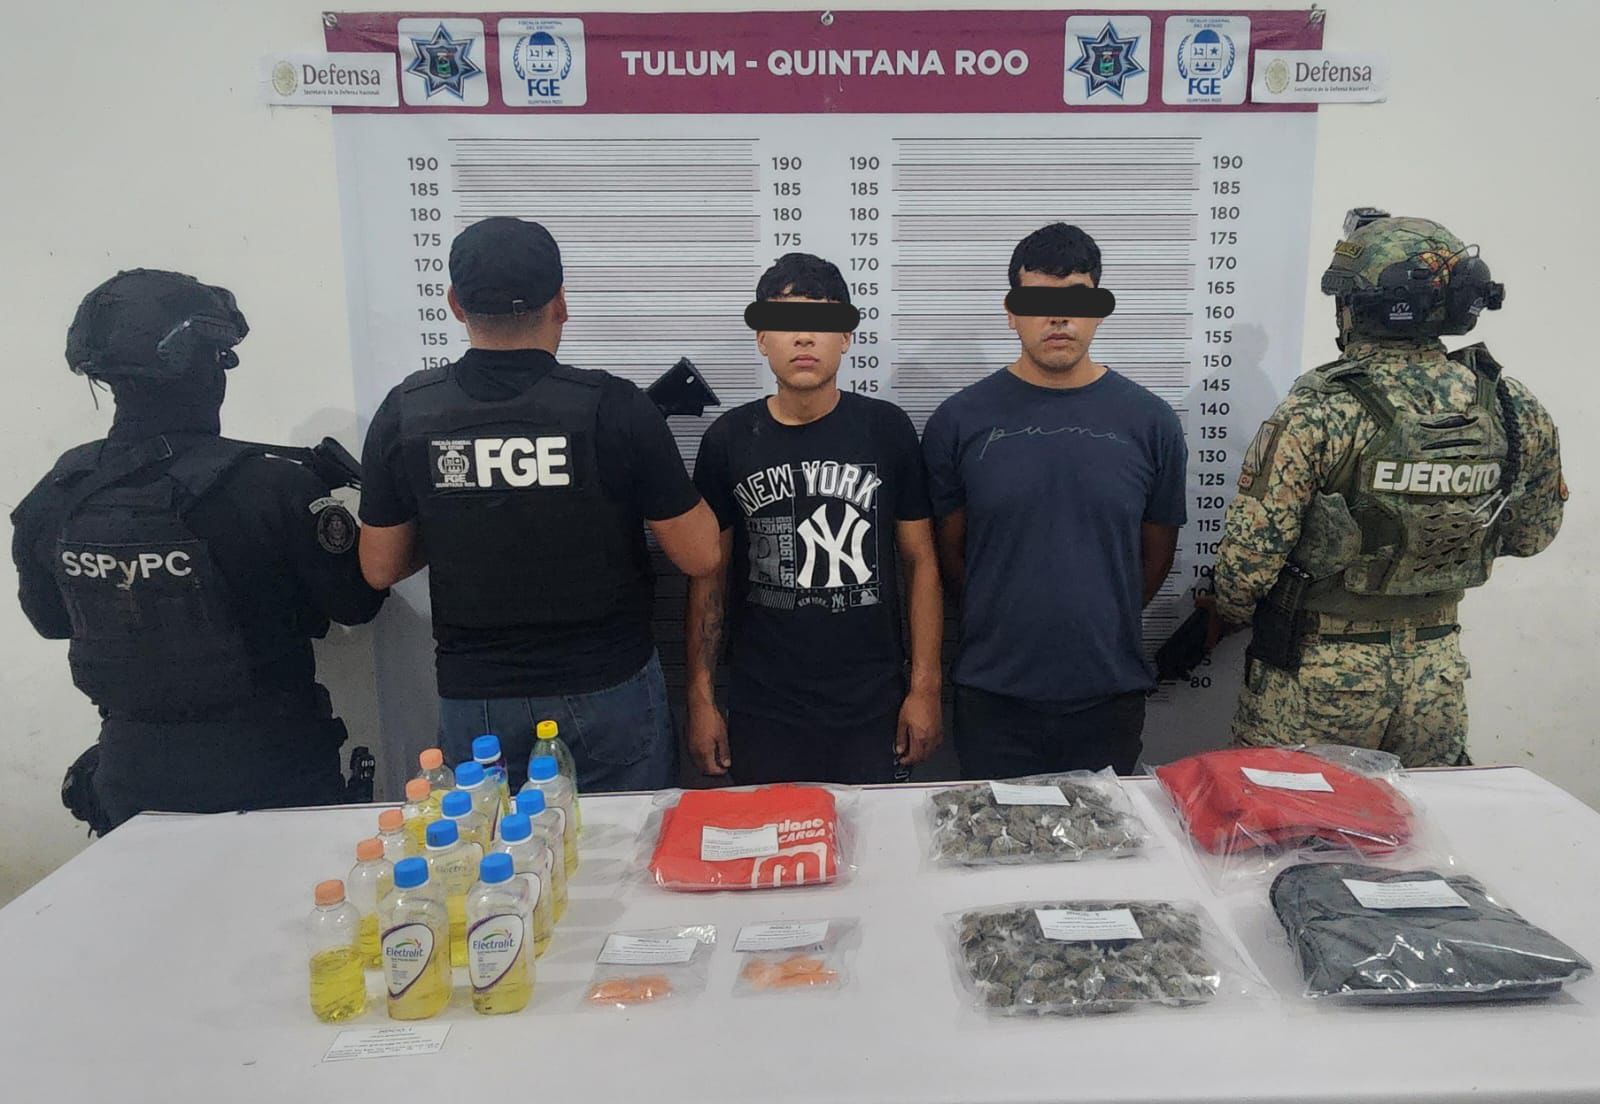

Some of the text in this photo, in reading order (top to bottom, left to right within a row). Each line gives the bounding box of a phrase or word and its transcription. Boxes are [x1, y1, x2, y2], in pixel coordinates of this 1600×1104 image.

[621, 50, 1030, 76] TULUM - QUINTANA ROO
[302, 63, 381, 85] Defensa
[1295, 60, 1372, 82] Defensa
[527, 78, 561, 97] FGE
[1188, 78, 1221, 95] FGE
[408, 157, 438, 171] 190
[772, 157, 802, 170] 190
[850, 157, 879, 170] 190
[1213, 156, 1243, 169] 190
[411, 183, 438, 196] 185
[774, 183, 800, 196] 185
[851, 182, 878, 195] 185
[1213, 181, 1240, 194] 185
[411, 208, 441, 221] 180
[773, 208, 802, 221] 180
[850, 208, 879, 220] 180
[1211, 207, 1240, 219] 180
[414, 233, 441, 246] 175
[774, 233, 801, 246] 175
[851, 233, 878, 246] 175
[1211, 232, 1237, 244] 175
[415, 259, 443, 271] 170
[850, 258, 879, 271] 170
[1209, 257, 1236, 269] 170
[417, 284, 445, 297] 165
[850, 284, 879, 296] 165
[1208, 281, 1234, 294] 165
[418, 309, 447, 321] 160
[858, 308, 879, 321] 60
[1206, 306, 1234, 319] 160
[421, 333, 448, 345] 155
[851, 332, 879, 345] 155
[1206, 331, 1232, 343] 155
[421, 357, 449, 370] 150
[850, 356, 879, 368] 150
[1204, 355, 1232, 367] 150
[851, 381, 879, 394] 145
[1203, 379, 1230, 391] 145
[1201, 403, 1229, 415] 140
[1201, 427, 1227, 439] 135
[979, 425, 1128, 460] puma
[474, 436, 570, 488] FGE
[1199, 450, 1226, 462] 130
[1199, 473, 1224, 486] 125
[1373, 461, 1501, 494] EJÉRCITO
[733, 460, 882, 516] NEW YORK
[1196, 497, 1224, 509] 120
[1198, 520, 1220, 531] 115
[779, 534, 794, 561] 1903
[1196, 543, 1218, 555] 110
[61, 550, 192, 589] SSPyPC
[1192, 565, 1214, 578] 10
[1190, 676, 1211, 688] 80
[778, 818, 824, 833] ilano
[472, 938, 514, 950] Electrolit
[385, 946, 424, 958] Electrolit
